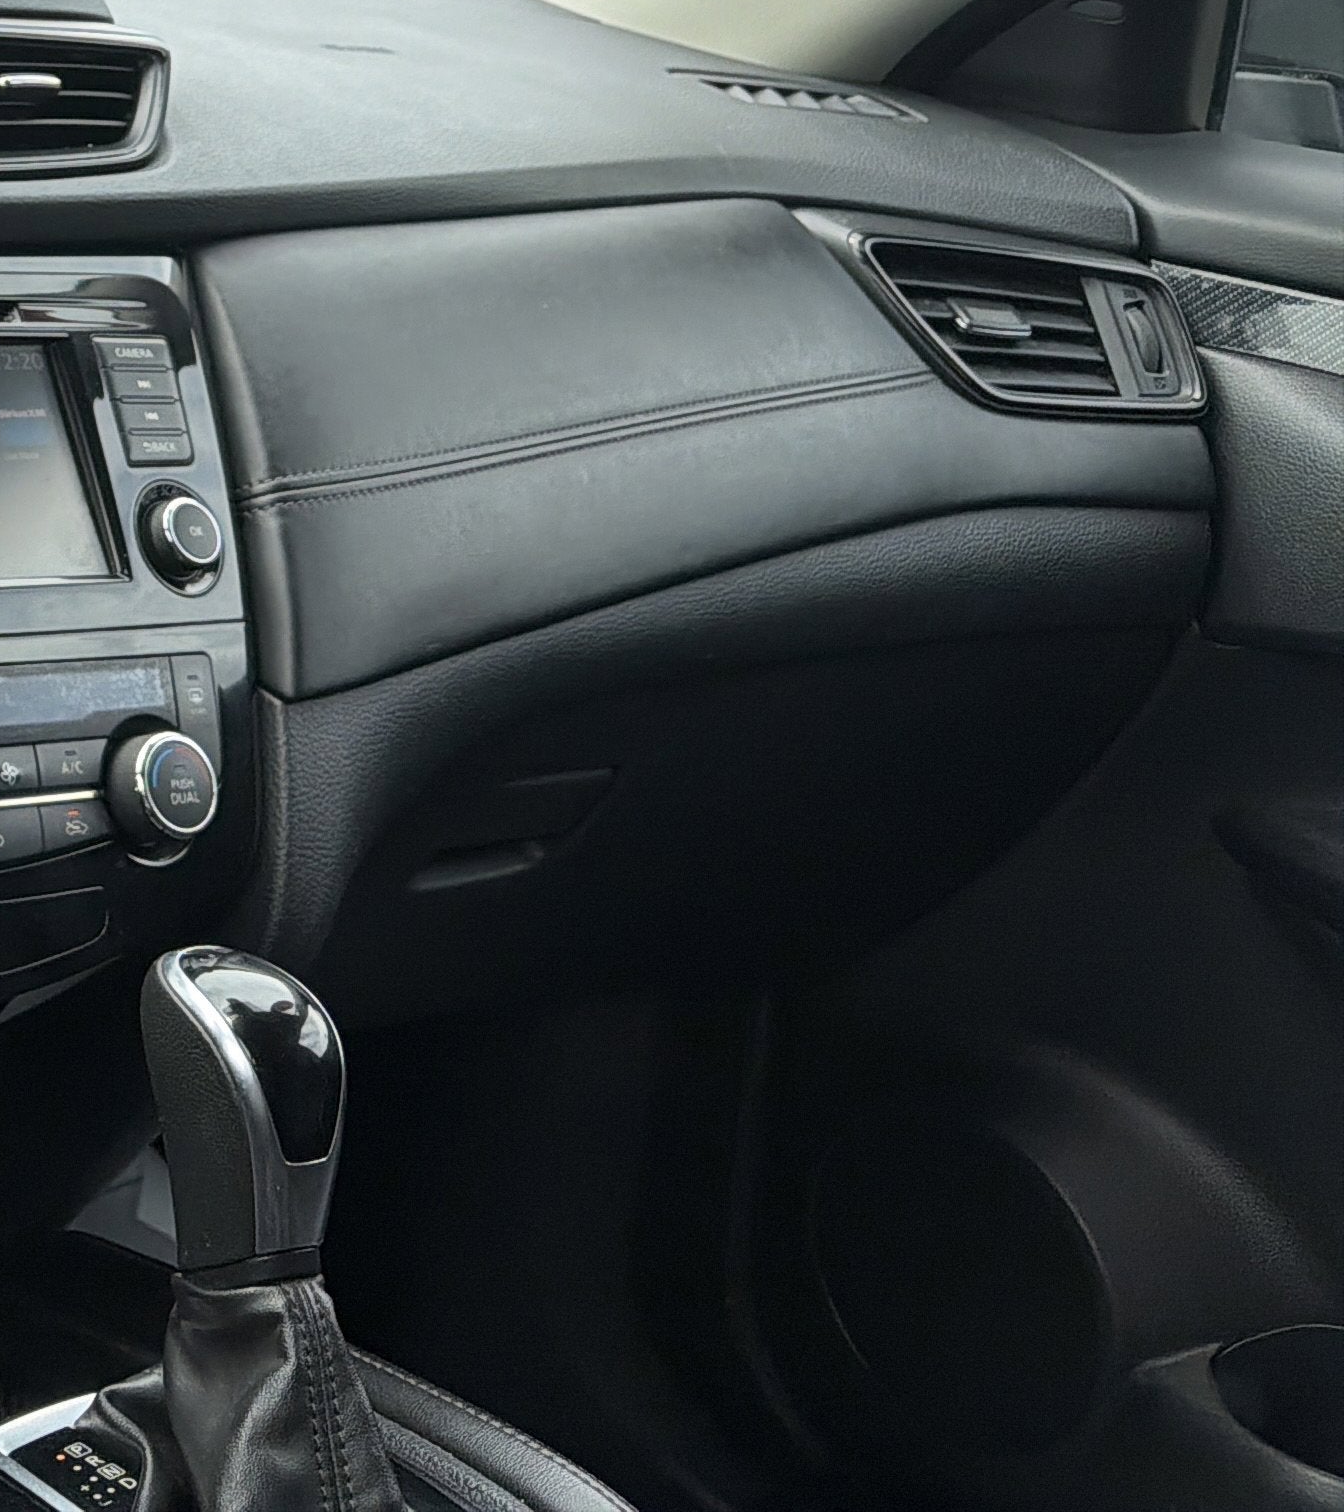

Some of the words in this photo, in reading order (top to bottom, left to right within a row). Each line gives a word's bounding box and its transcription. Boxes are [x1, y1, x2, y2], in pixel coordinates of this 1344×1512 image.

[115, 347, 154, 359] CAMERA
[61, 759, 84, 776] A/C
[170, 778, 195, 791] PUSH
[170, 791, 200, 806] DUAL
[84, 1455, 106, 1467] R
[118, 1477, 138, 1490] D
